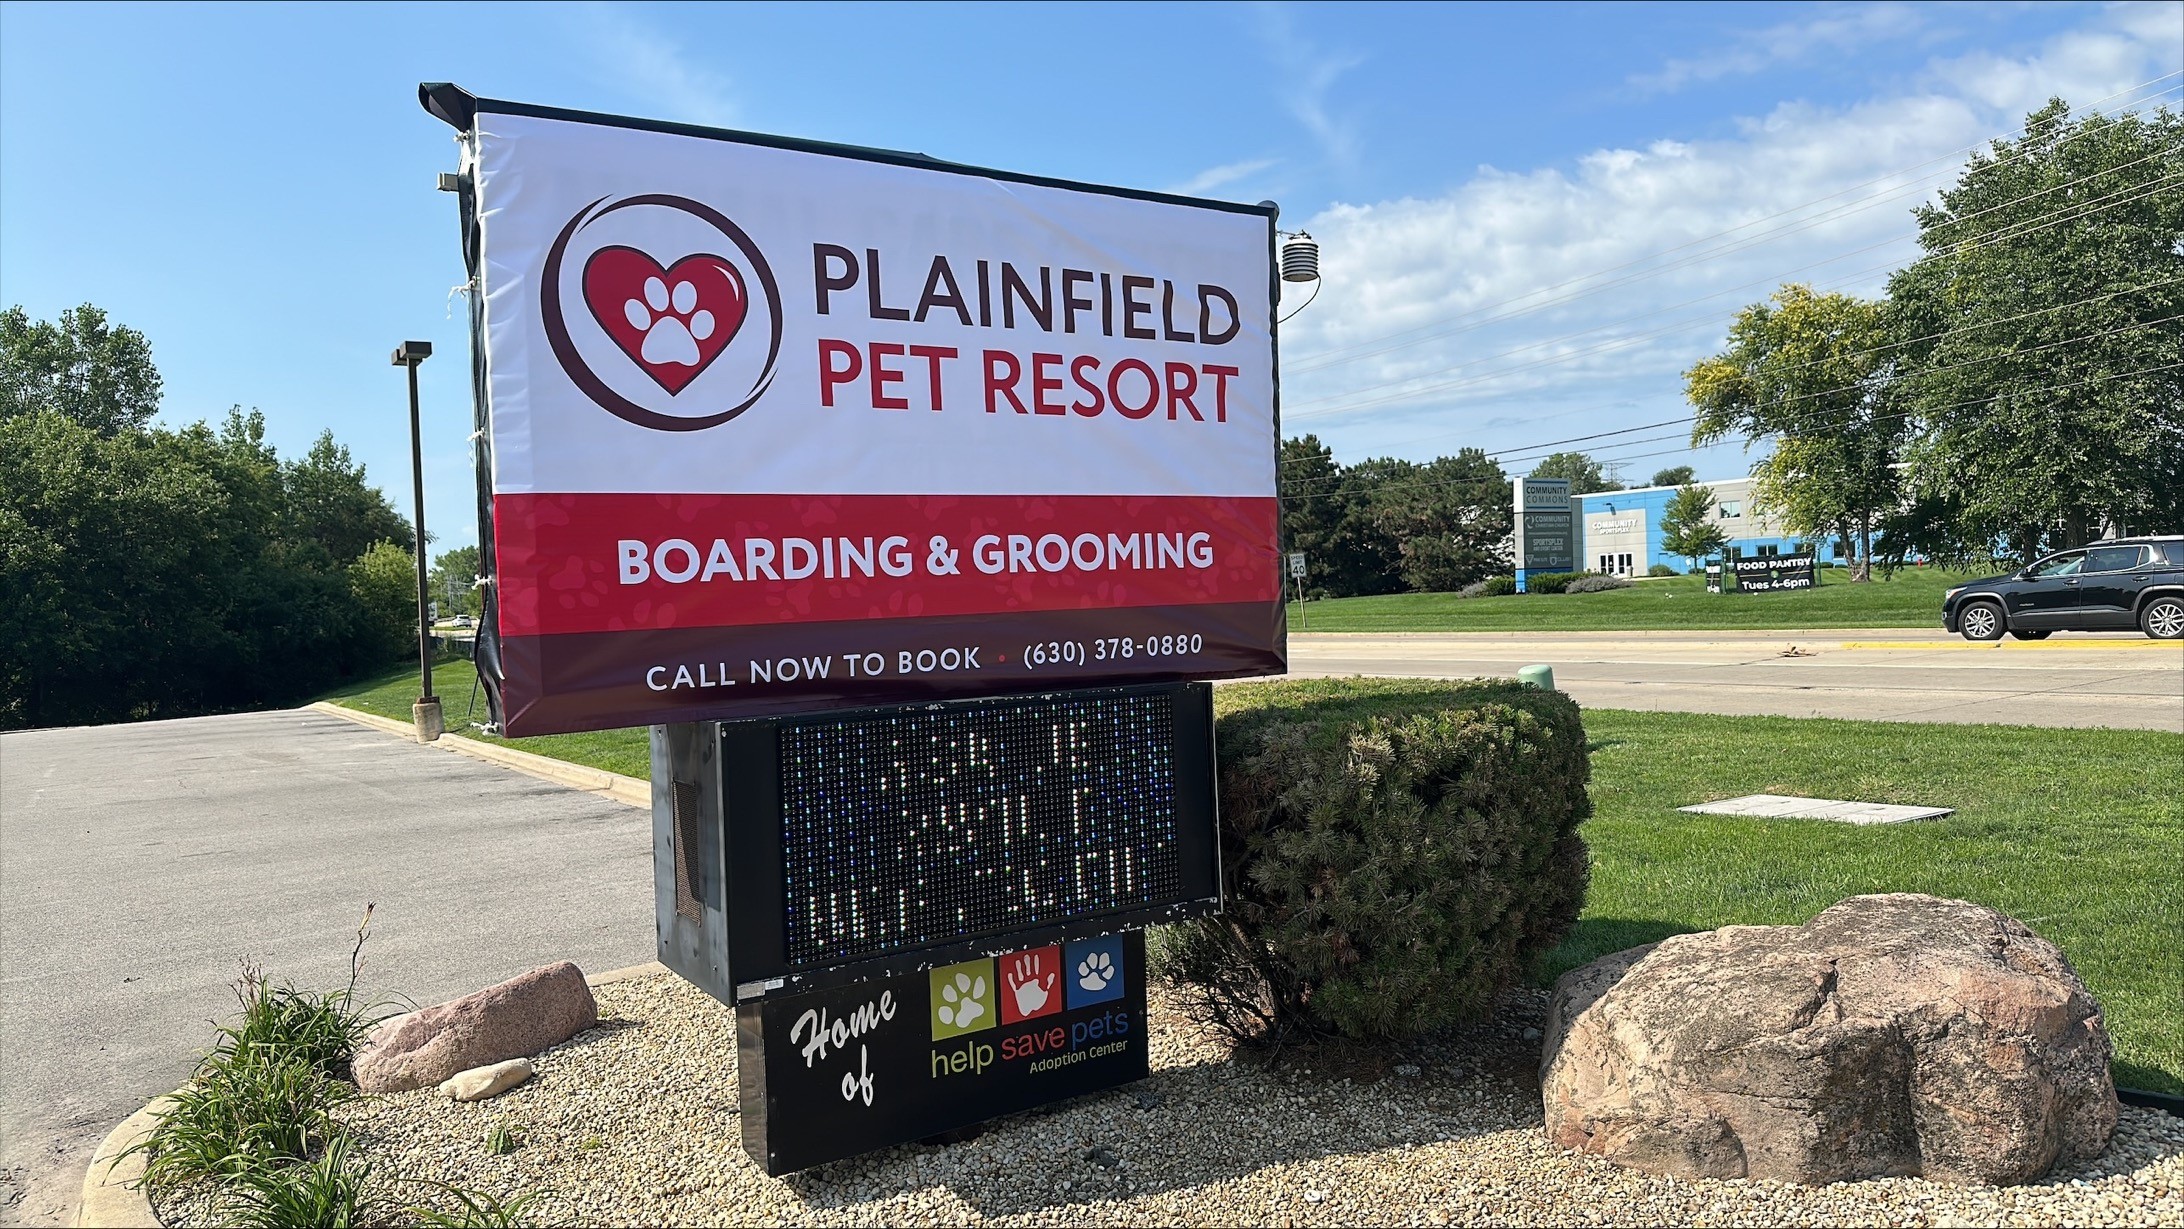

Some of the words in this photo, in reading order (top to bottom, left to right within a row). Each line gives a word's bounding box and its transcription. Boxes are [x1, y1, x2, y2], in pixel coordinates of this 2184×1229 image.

[813, 242, 1240, 345] PLAINFIELD
[818, 339, 958, 411] PET
[983, 349, 1239, 422] RESORT
[1526, 486, 1567, 494] COMMUNITY
[1592, 519, 1637, 530] COMMUNITY
[617, 536, 913, 585] BOARDING
[926, 535, 961, 575] &
[973, 532, 1213, 575] GROOMING
[1292, 565, 1305, 574] 40
[1736, 562, 1767, 570] FOOD
[1769, 557, 1812, 568] PANTRY
[1742, 581, 1769, 590] Tues
[1771, 579, 1810, 589] 4-6pm
[646, 661, 736, 691] CALL
[749, 655, 831, 682] NOW
[843, 653, 885, 678] TO
[899, 647, 981, 674] BOOK
[1023, 642, 1086, 671] (630)
[1094, 633, 1203, 660] 378-0880
[790, 990, 896, 1068] Home
[932, 1041, 994, 1078] help
[1001, 1026, 1065, 1061] save
[1071, 1010, 1129, 1049] pets
[842, 1044, 874, 1107] of
[1030, 1051, 1086, 1074] Adoption
[1090, 1038, 1128, 1058] Center
